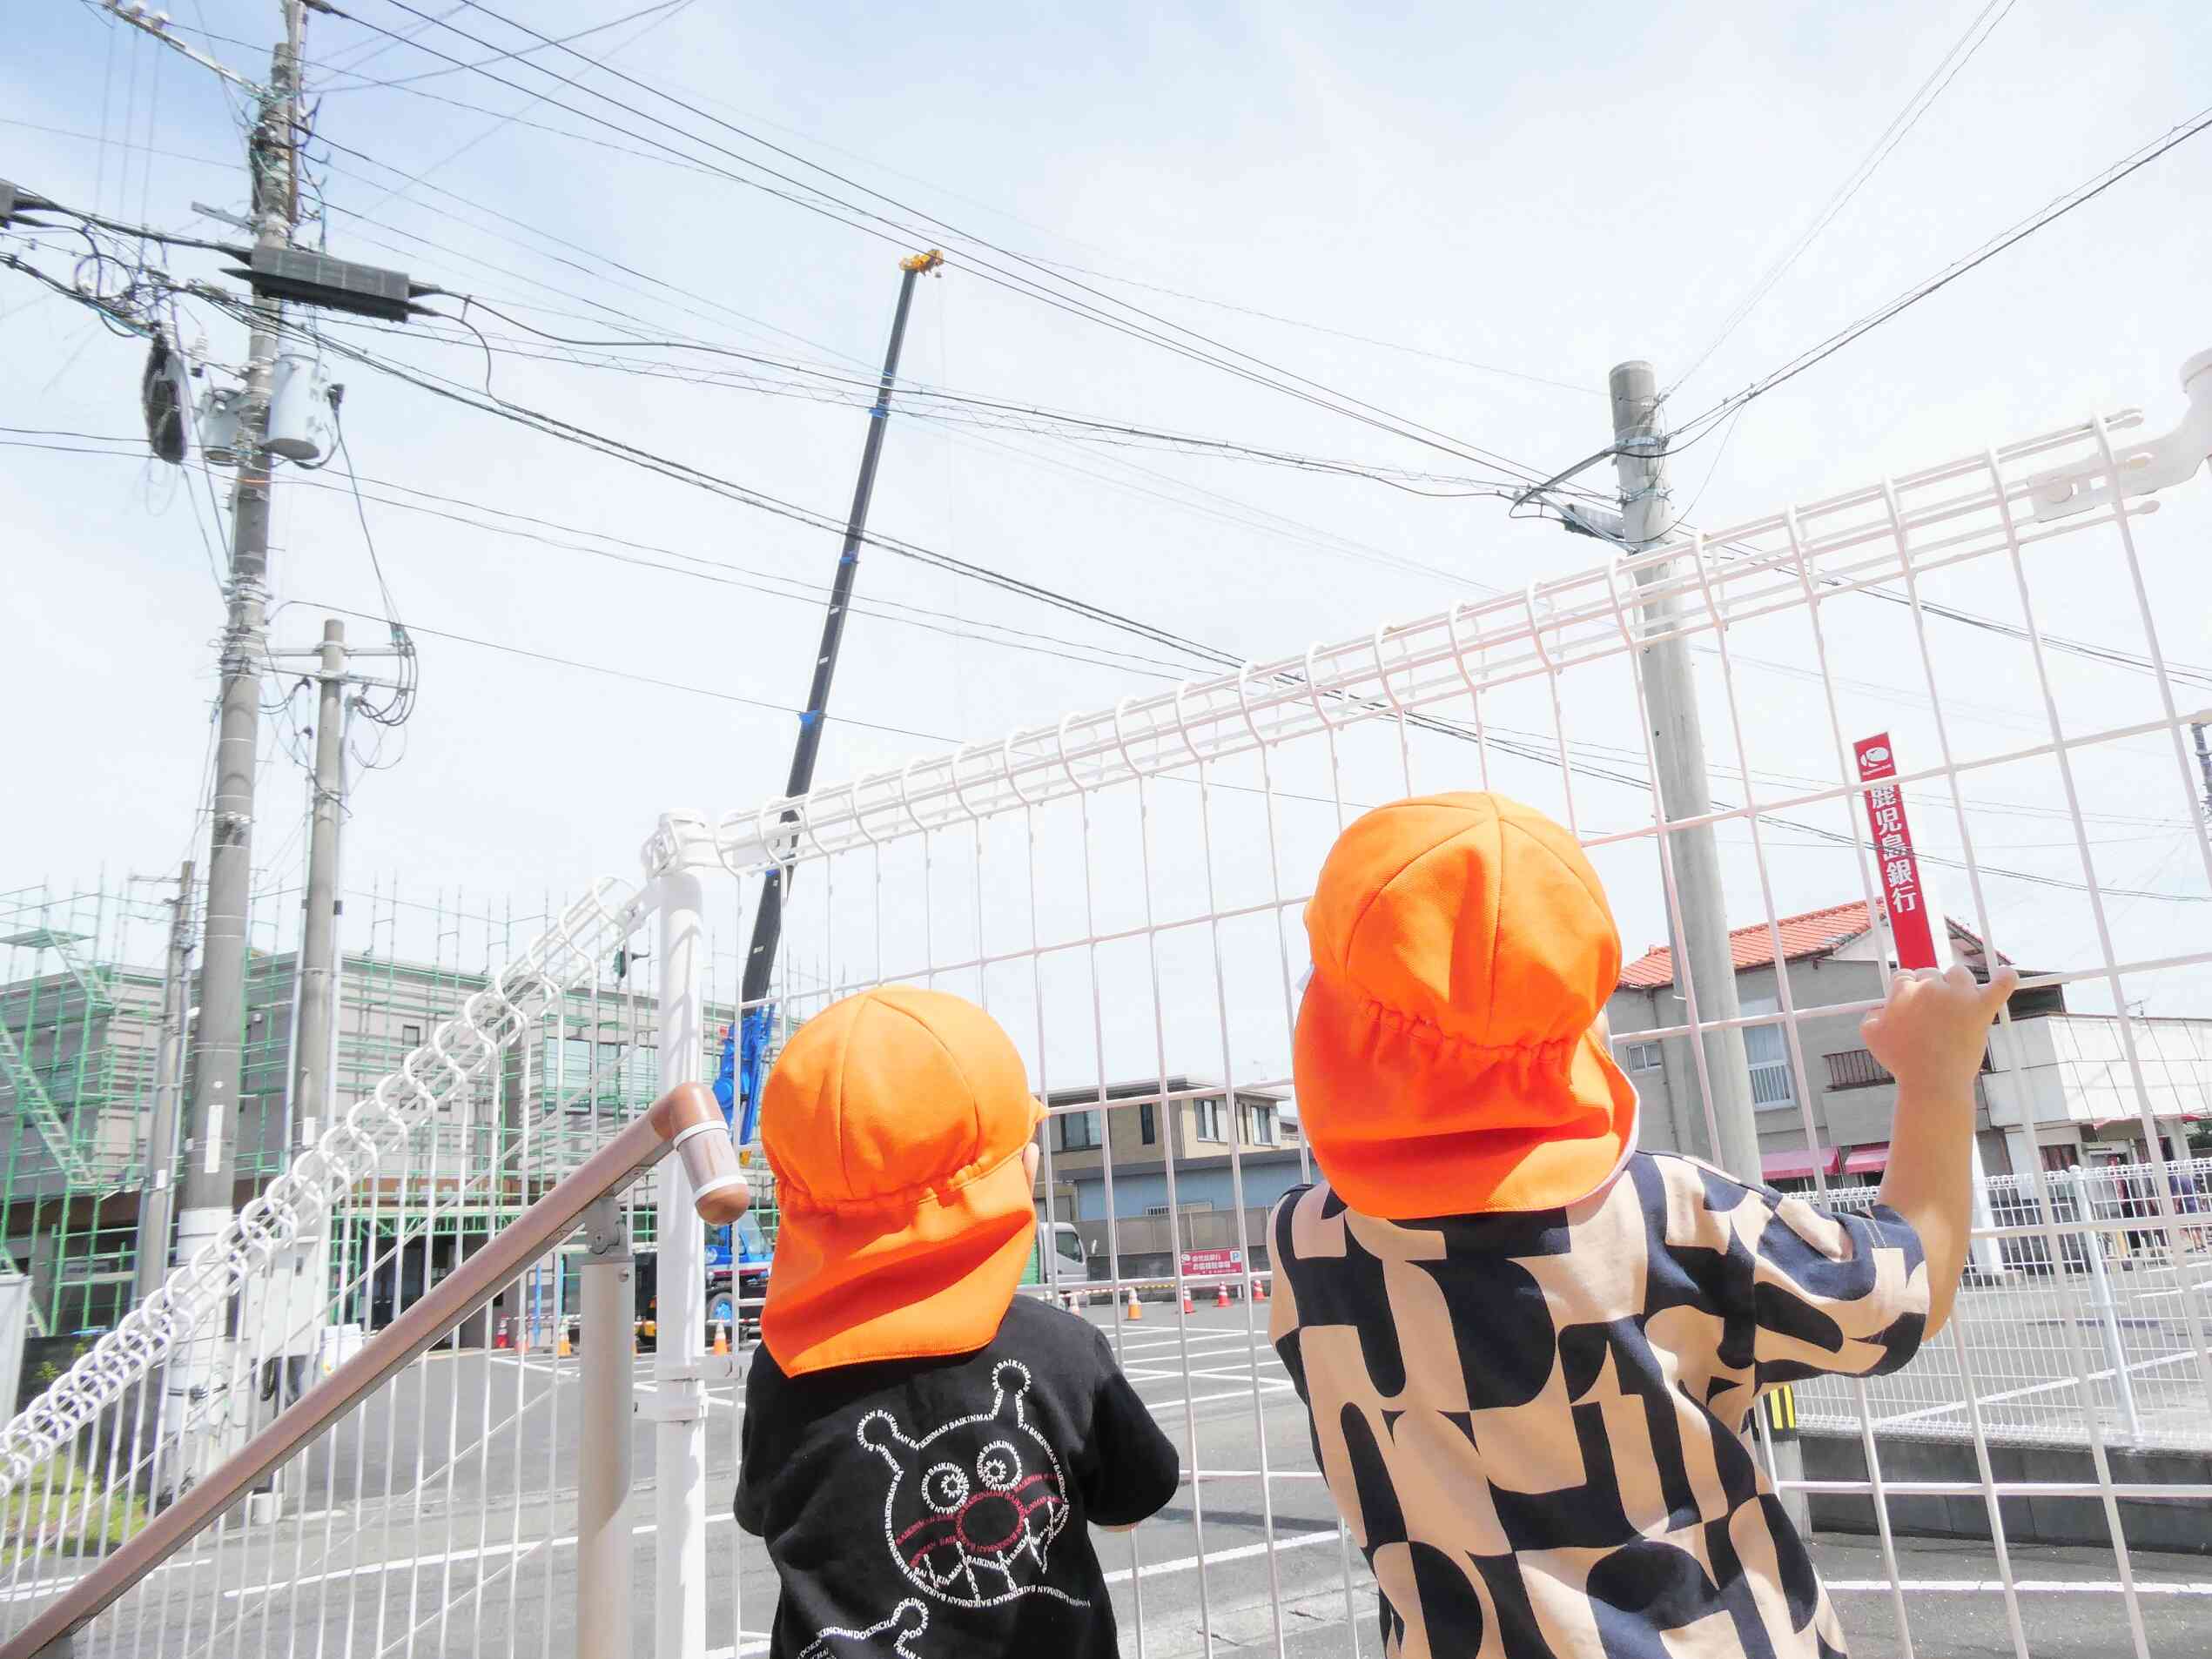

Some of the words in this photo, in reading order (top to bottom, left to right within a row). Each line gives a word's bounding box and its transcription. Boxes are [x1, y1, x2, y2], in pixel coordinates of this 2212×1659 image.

[1871, 785, 1917, 914] 鹿児島銀行
[948, 1413, 993, 1429] BAIKINMAN
[997, 1359, 1031, 1393] BAIKINMAN
